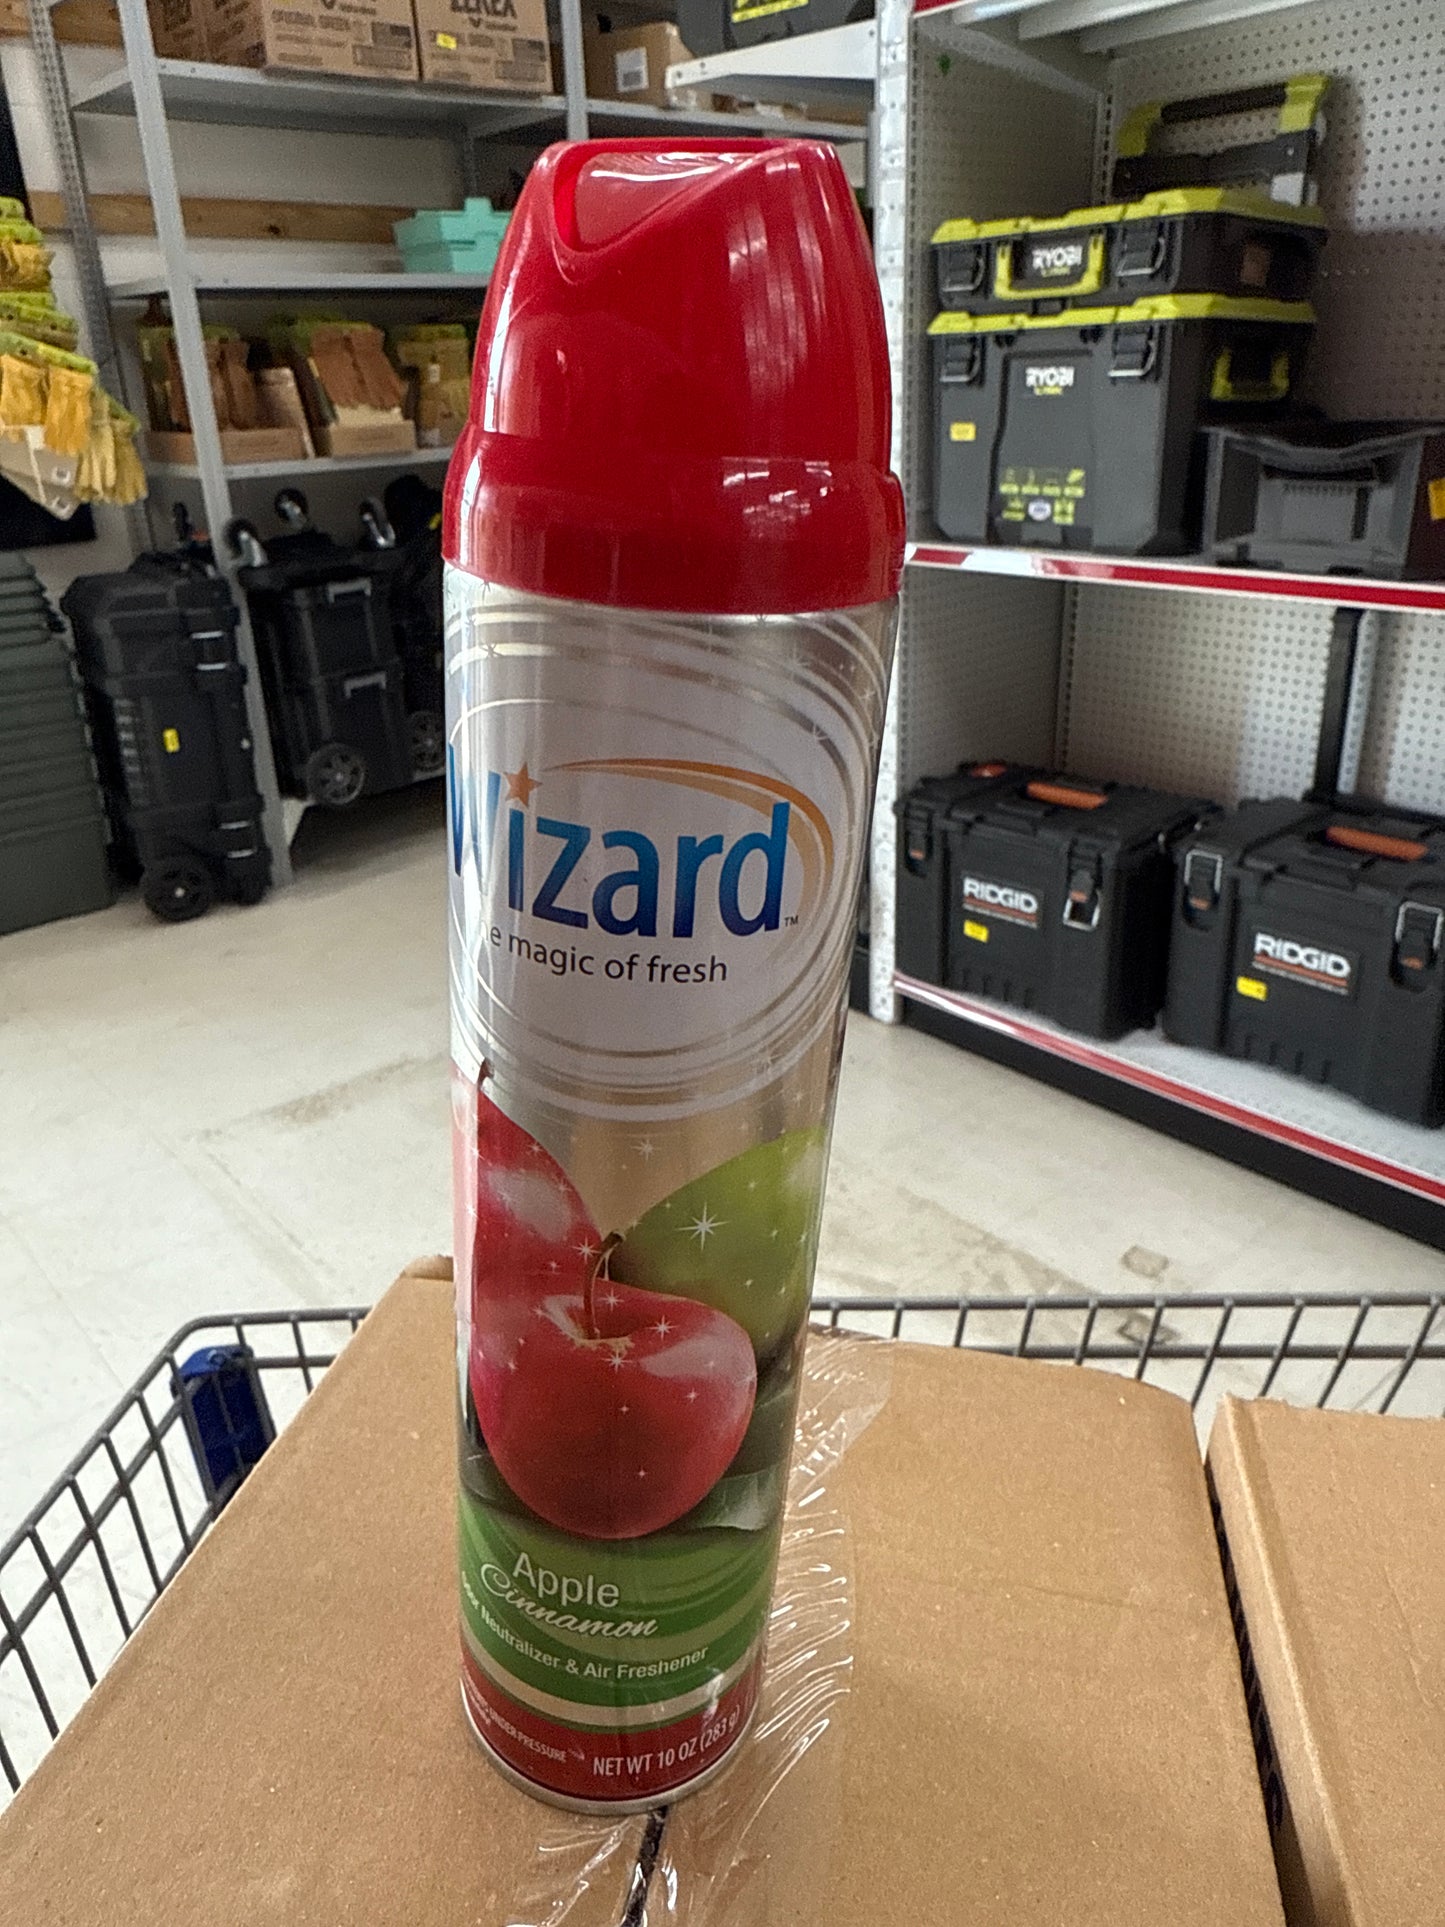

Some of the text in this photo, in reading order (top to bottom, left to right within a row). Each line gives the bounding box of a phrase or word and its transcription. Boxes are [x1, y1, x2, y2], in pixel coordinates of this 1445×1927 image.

[1032, 245, 1083, 270] RYOBI
[1025, 366, 1075, 388] RYOBI
[448, 742, 790, 938] Wizard
[963, 877, 1038, 914] RIDGID
[509, 934, 594, 976] magic
[605, 954, 640, 979] of
[647, 955, 728, 983] fresh
[1254, 932, 1351, 978] RIDGID
[480, 1563, 659, 1639] Cinnamon
[512, 1552, 620, 1609] Apple
[480, 1605, 709, 1680] Neutralizer & Air Freshener
[516, 1731, 566, 1763] PRESSURE
[593, 1757, 624, 1777] NET
[626, 1753, 654, 1775] WT
[657, 1748, 675, 1770] 10
[678, 1737, 698, 1762] OZ
[699, 1716, 728, 1752] (283
